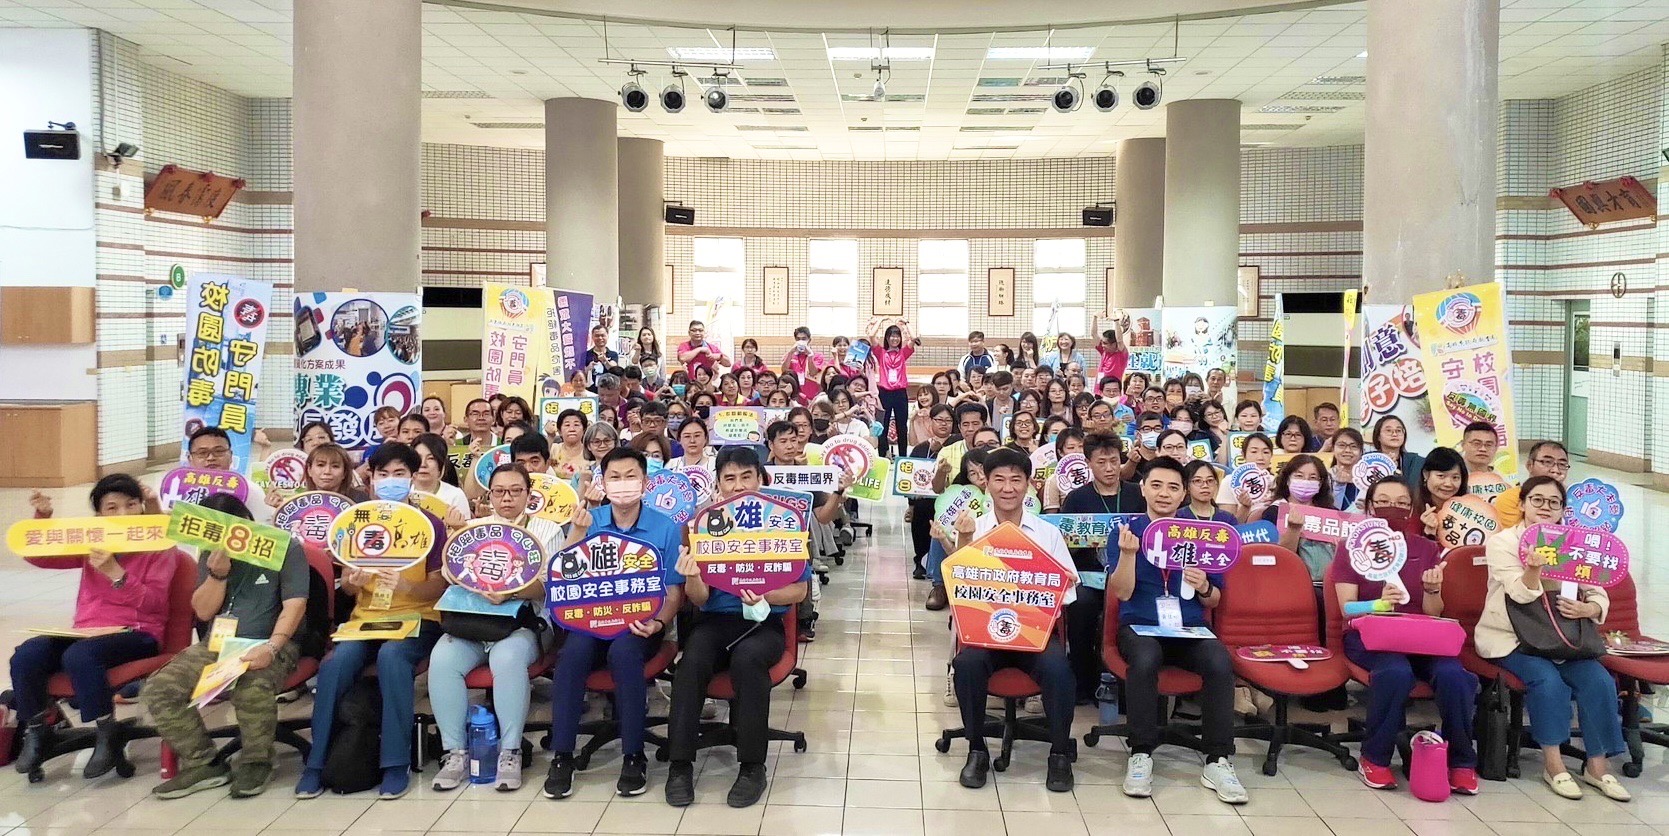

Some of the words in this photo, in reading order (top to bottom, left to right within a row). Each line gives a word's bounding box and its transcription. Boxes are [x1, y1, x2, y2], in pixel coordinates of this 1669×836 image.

[184, 472, 239, 489] 高雄反毒
[773, 473, 834, 485] 反毒無國界
[858, 477, 881, 490] LIFE
[1070, 469, 1086, 485] 毒
[1468, 483, 1507, 494] 康校園
[354, 509, 371, 523] 無
[734, 501, 763, 529] 雄
[769, 516, 797, 530] 安全
[938, 488, 972, 526] 高雄反毒
[1450, 501, 1497, 531] 健康校園
[25, 525, 165, 546] 愛與關懷一起來
[180, 515, 276, 559] 拒毒8招
[393, 518, 429, 549] 高雄
[449, 525, 502, 557] 拒絕毒品
[1168, 525, 1230, 543] 高雄反毒
[1348, 521, 1386, 549] KAOHSIUNG
[590, 543, 618, 570] 雄
[623, 553, 655, 569] 安全
[696, 538, 803, 555] 校園安全事務室
[1170, 542, 1198, 567] 雄
[1199, 551, 1232, 567] 安全
[1368, 539, 1393, 564] 毒
[1568, 546, 1619, 571] 不要找
[951, 565, 1061, 588] 高雄市政府教育局
[1575, 564, 1593, 579] 煩
[550, 576, 661, 602] 校園安全事務室
[954, 585, 1056, 608] 校園安全事務室
